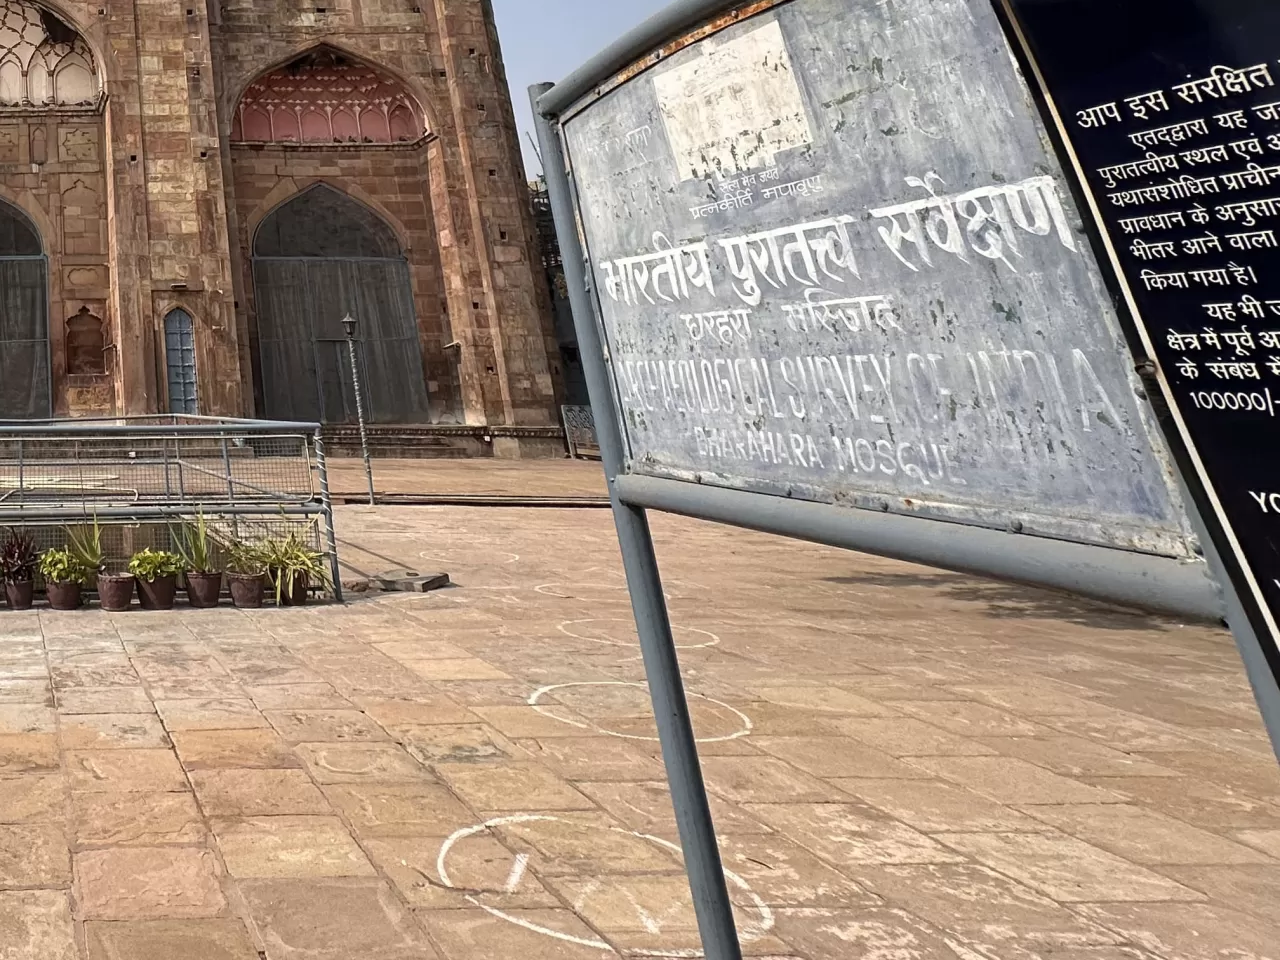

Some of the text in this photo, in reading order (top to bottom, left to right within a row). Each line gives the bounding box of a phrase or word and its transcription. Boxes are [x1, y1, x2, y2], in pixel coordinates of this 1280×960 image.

[1076, 63, 1275, 129] आप इस संरक्षित
[1213, 110, 1248, 129] यह
[1096, 151, 1180, 189] पुरातत्वीय
[1179, 144, 1229, 167] स्थल
[1228, 132, 1264, 161] एवं
[1107, 175, 1221, 208] यथासंशोधित
[1118, 210, 1186, 235] प्रावधान
[1187, 203, 1210, 225] के
[599, 230, 716, 307] भारतीय
[868, 170, 1078, 273] सर्वेक्षण
[1129, 230, 1279, 261] भीतर आने वाला
[1140, 268, 1189, 291] किया
[1188, 268, 1230, 287] गया
[1202, 303, 1236, 321] यह
[1237, 294, 1265, 318] भी
[1166, 328, 1201, 351] क्षेत्र
[1200, 326, 1221, 350] में
[1220, 325, 1256, 356] पूर्व
[1175, 356, 1199, 380] के
[1205, 356, 1261, 380] संबंध
[780, 353, 901, 424] SURVEY
[831, 435, 968, 486] MOSQUE
